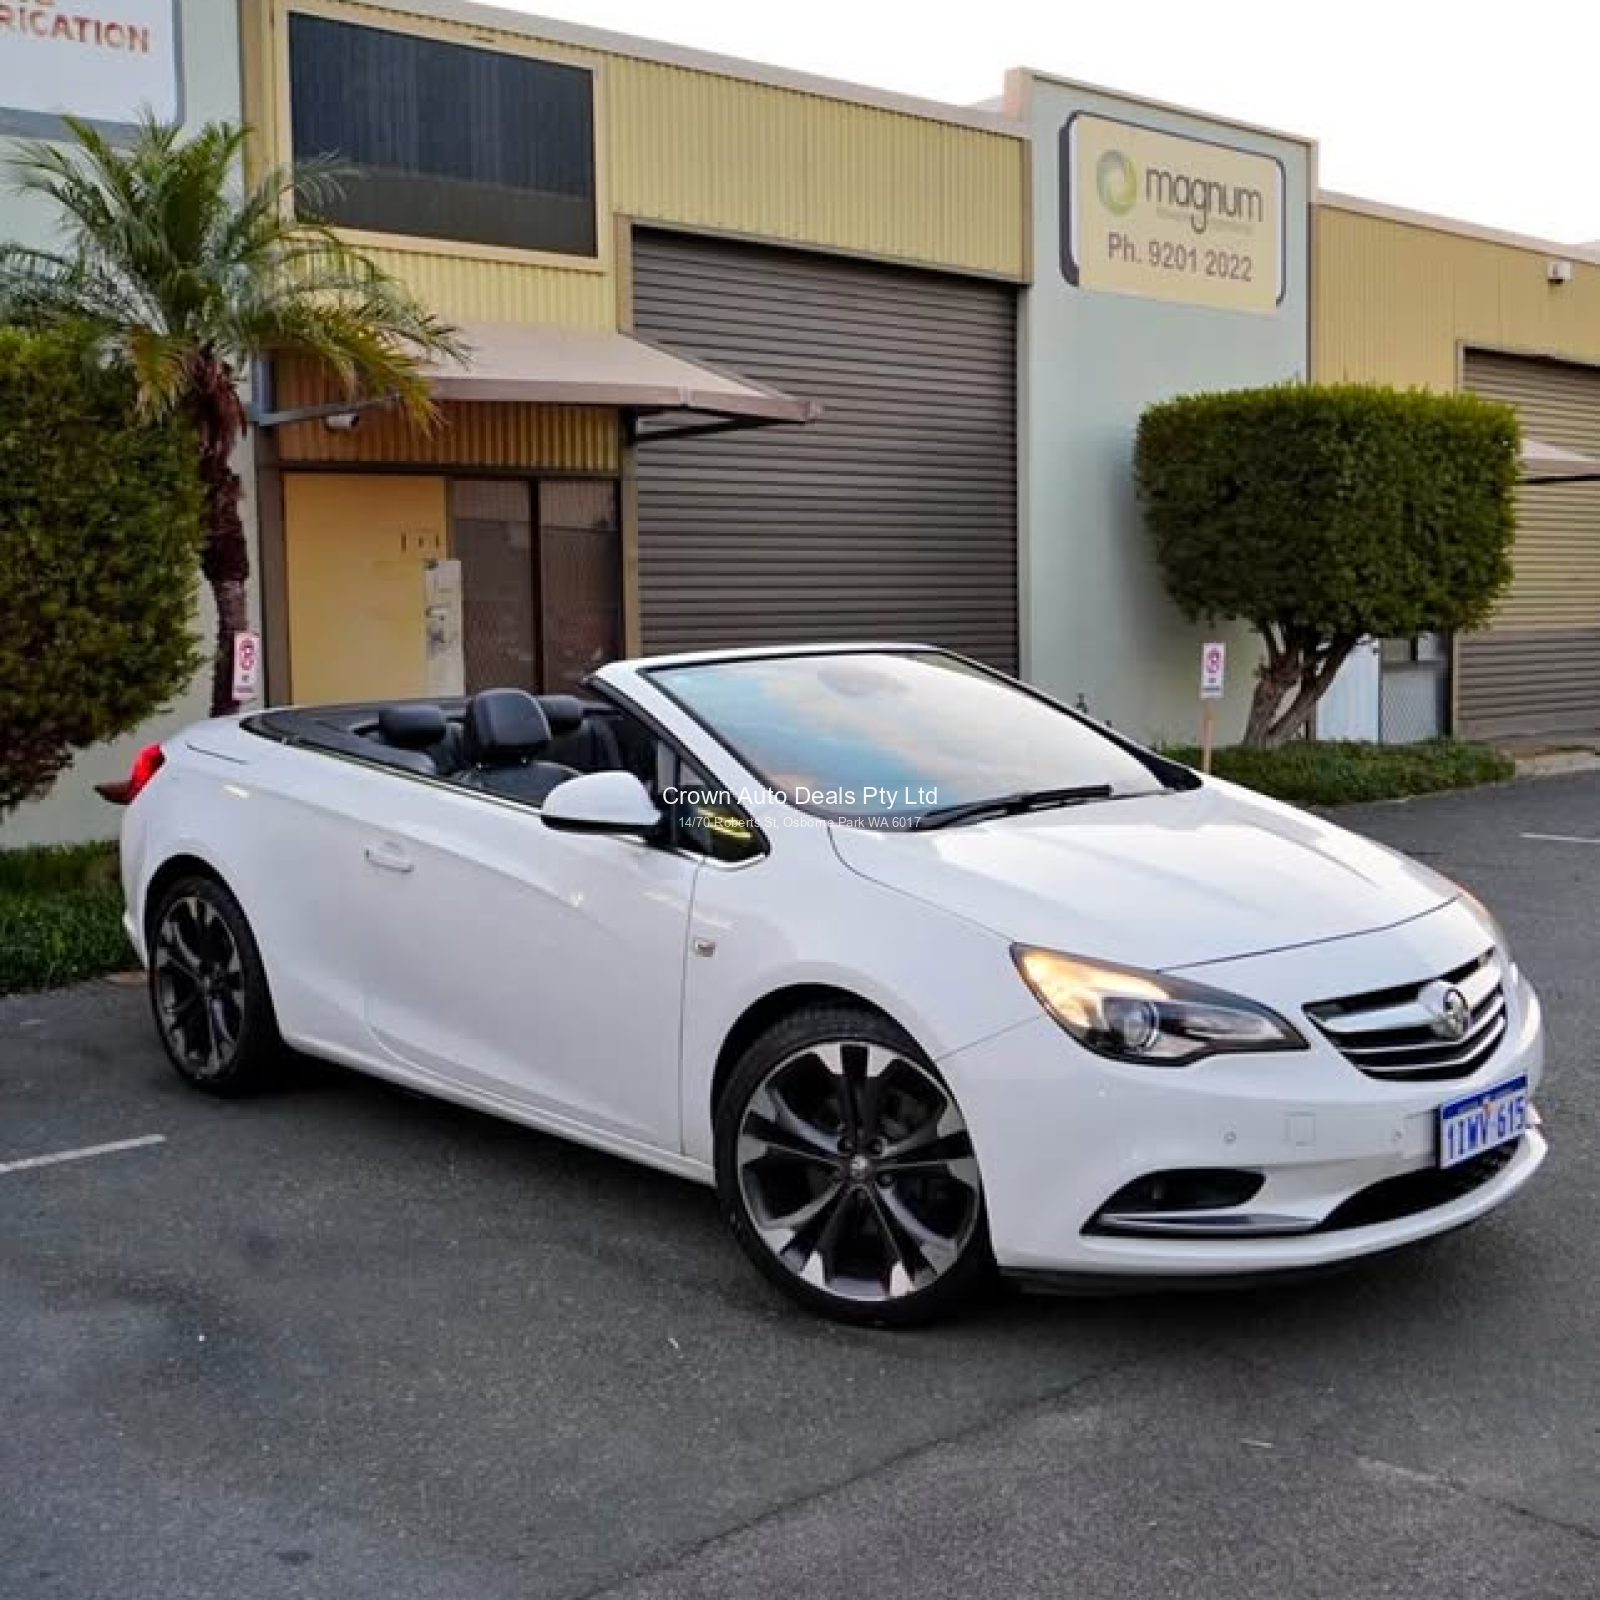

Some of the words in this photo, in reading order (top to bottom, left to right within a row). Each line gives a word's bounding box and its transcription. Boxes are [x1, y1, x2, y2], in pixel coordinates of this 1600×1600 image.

[1145, 166, 1263, 234] magnum
[1108, 231, 1142, 263] Ph.
[1149, 239, 1197, 273] 9201
[1205, 249, 1252, 283] 2022
